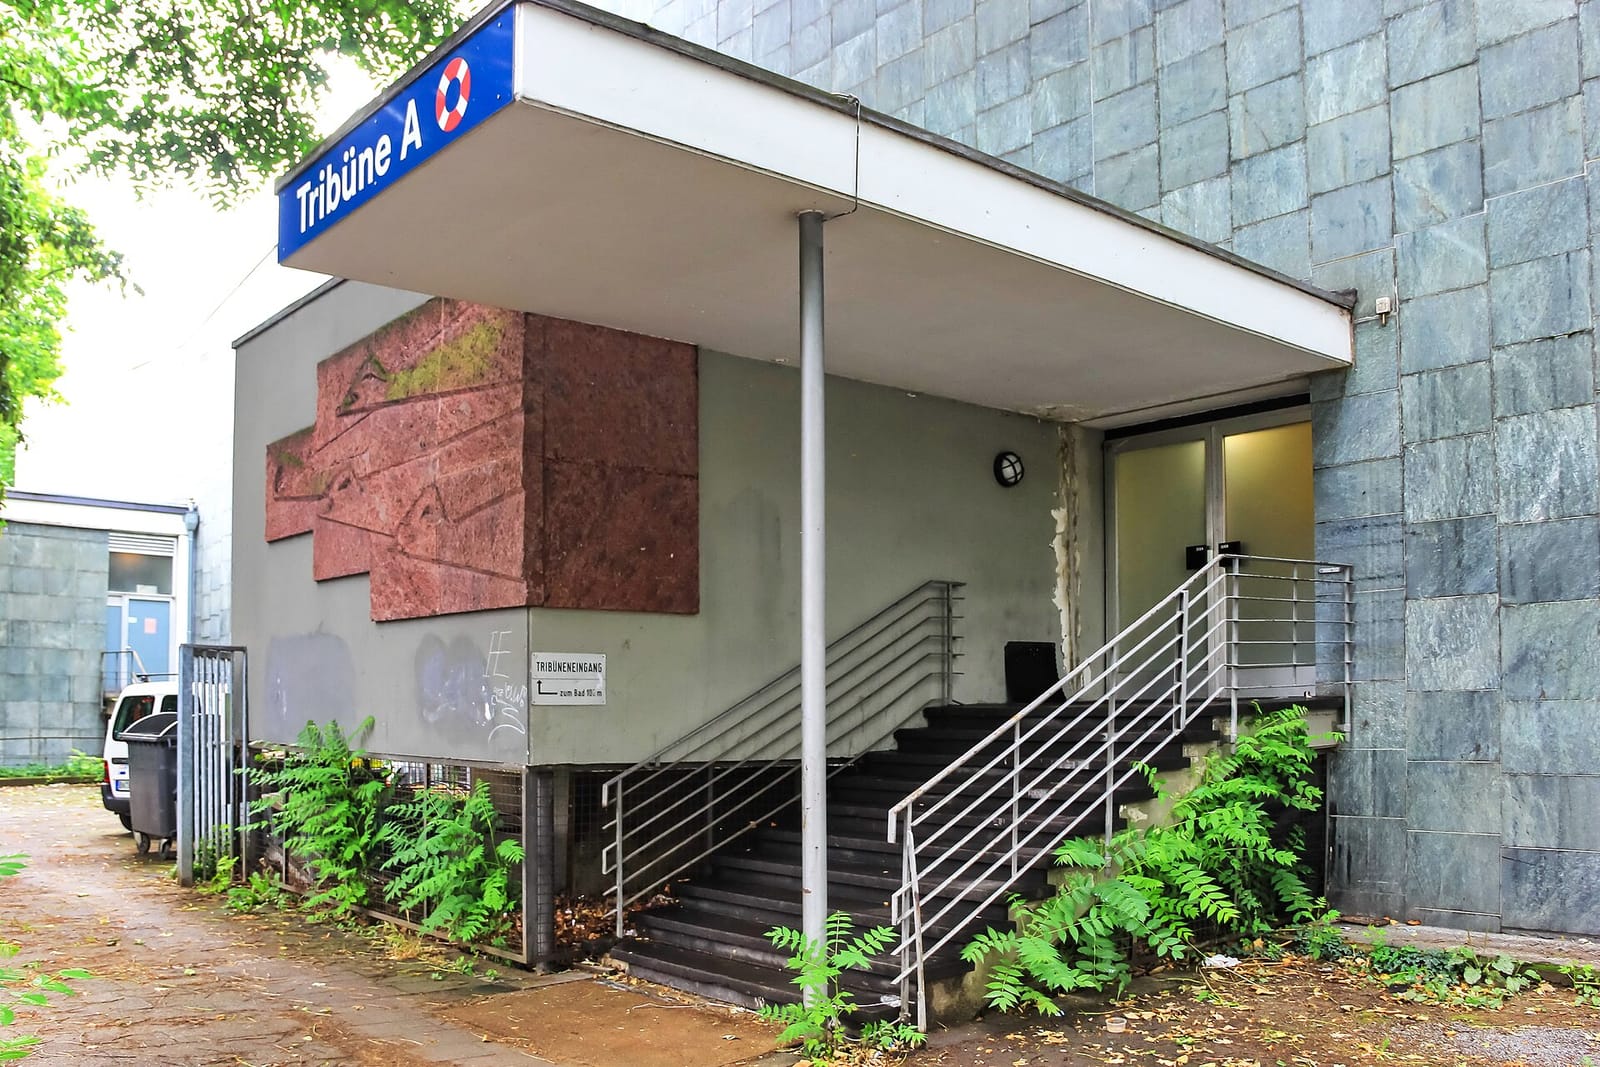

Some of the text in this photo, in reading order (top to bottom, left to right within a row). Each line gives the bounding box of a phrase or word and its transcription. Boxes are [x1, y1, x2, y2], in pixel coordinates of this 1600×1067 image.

[297, 98, 423, 233] Tribüne A
[536, 661, 602, 673] TRIBÜNENEINGANG
[574, 688, 585, 697] Bad
